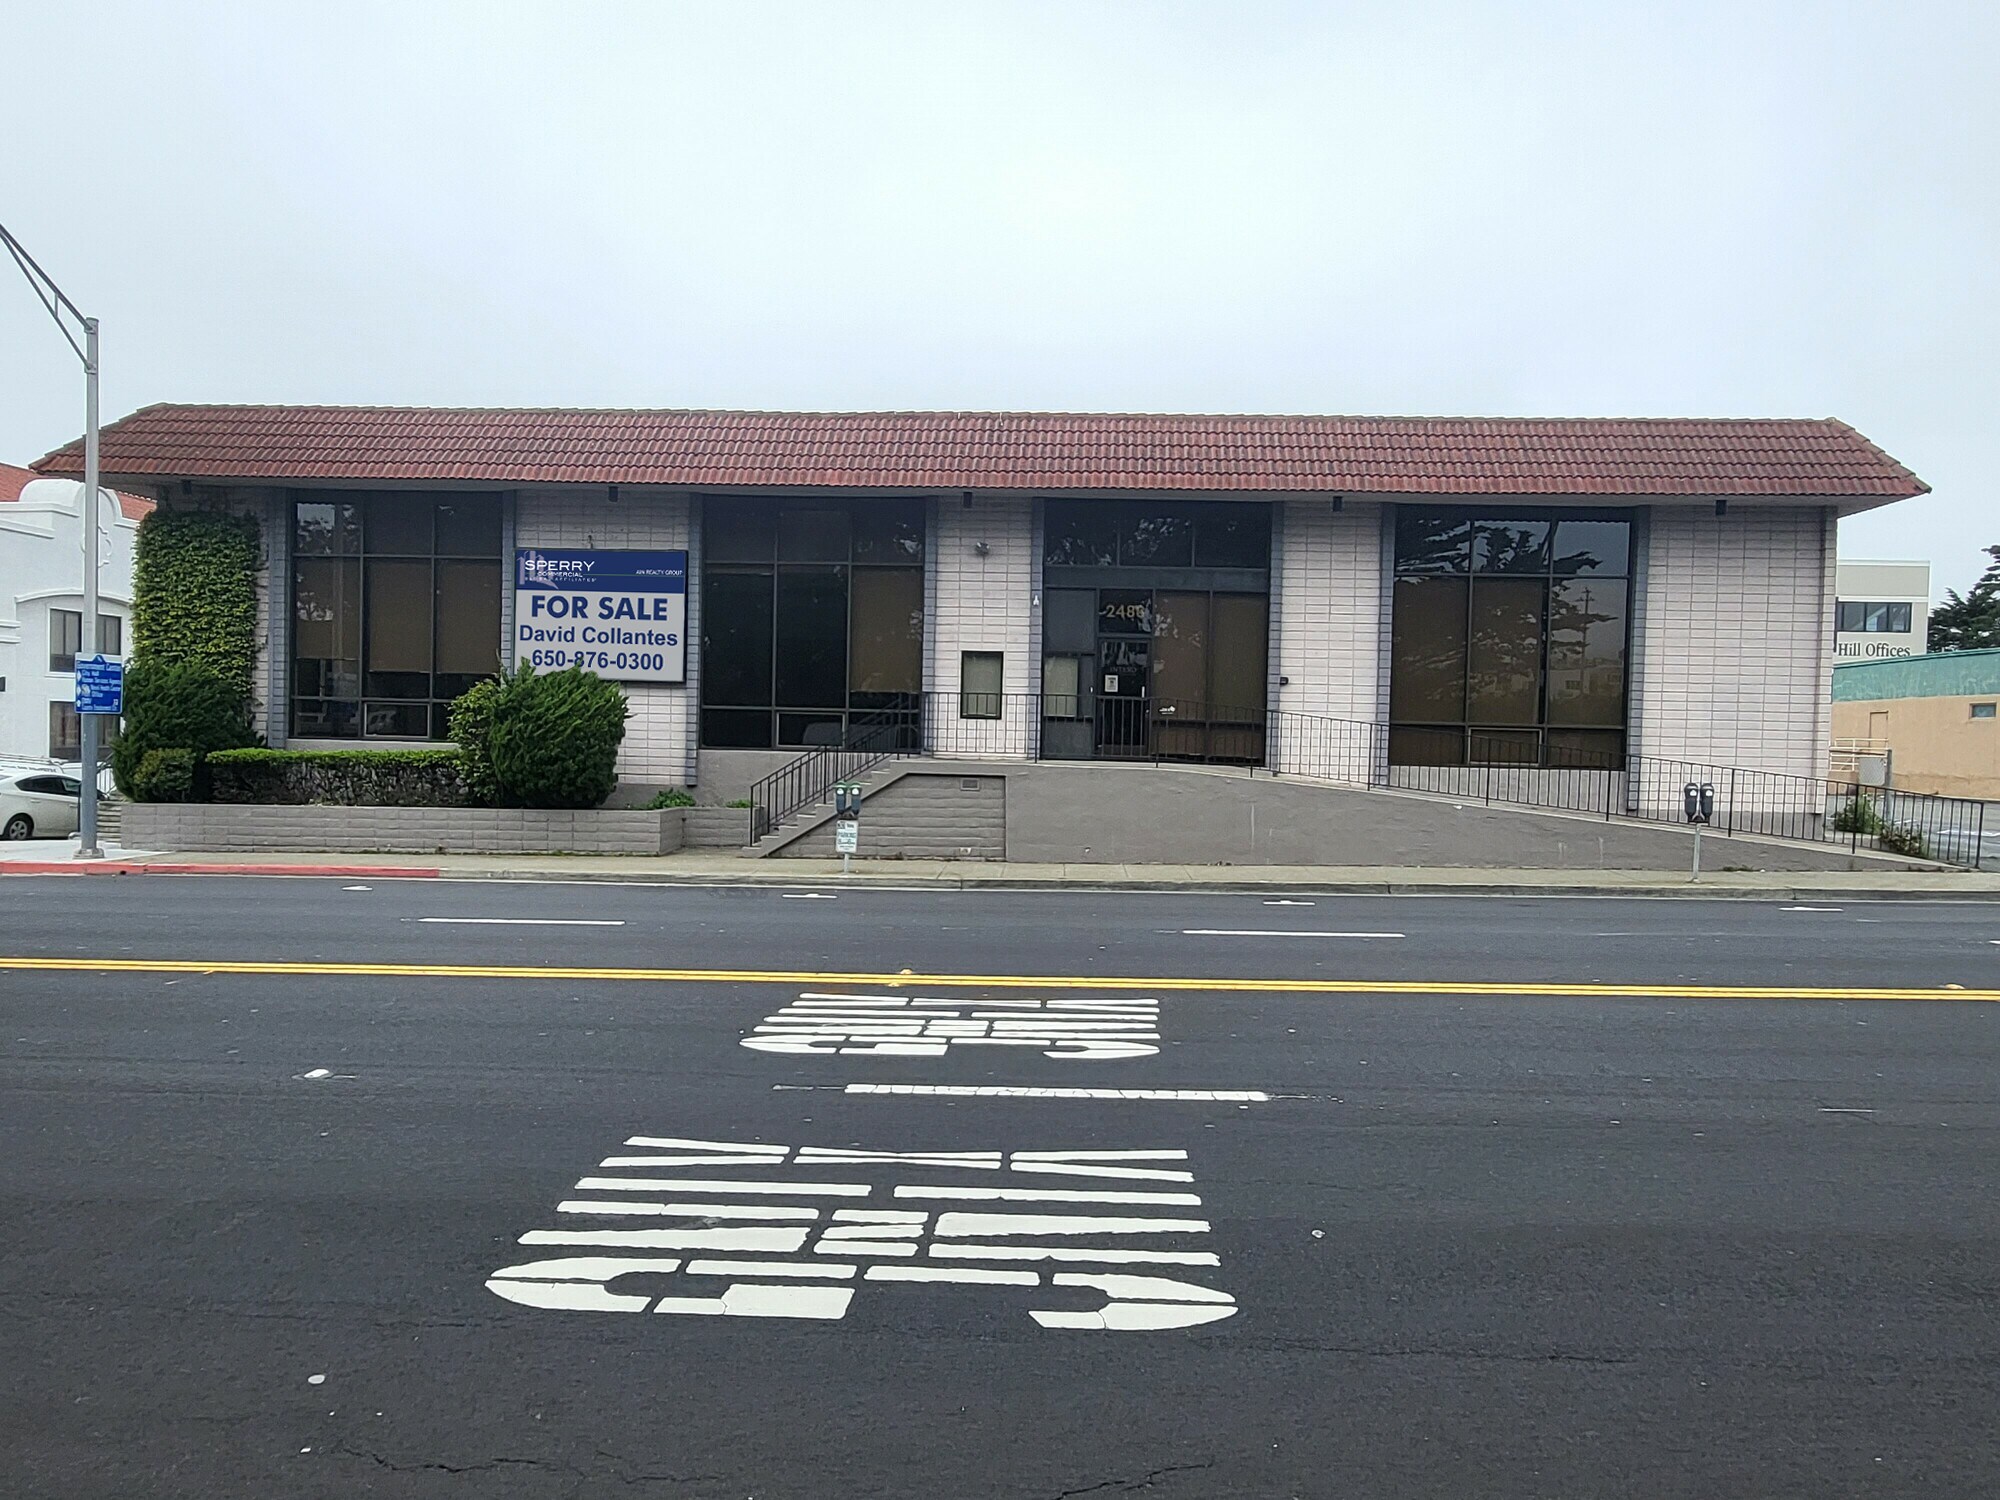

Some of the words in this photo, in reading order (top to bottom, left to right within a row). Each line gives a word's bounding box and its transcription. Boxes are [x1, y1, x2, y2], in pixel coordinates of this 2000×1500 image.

[524, 560, 595, 571] SPERRY
[531, 595, 588, 619] FOR
[598, 597, 668, 621] SALE
[519, 625, 575, 643] David
[582, 626, 678, 646] Collantes
[532, 649, 664, 671] 650-876-0300
[1838, 642, 1861, 657] Hill
[1865, 642, 1911, 658] Offices
[739, 992, 1161, 1060] XING
[484, 1135, 1239, 1331] XING
